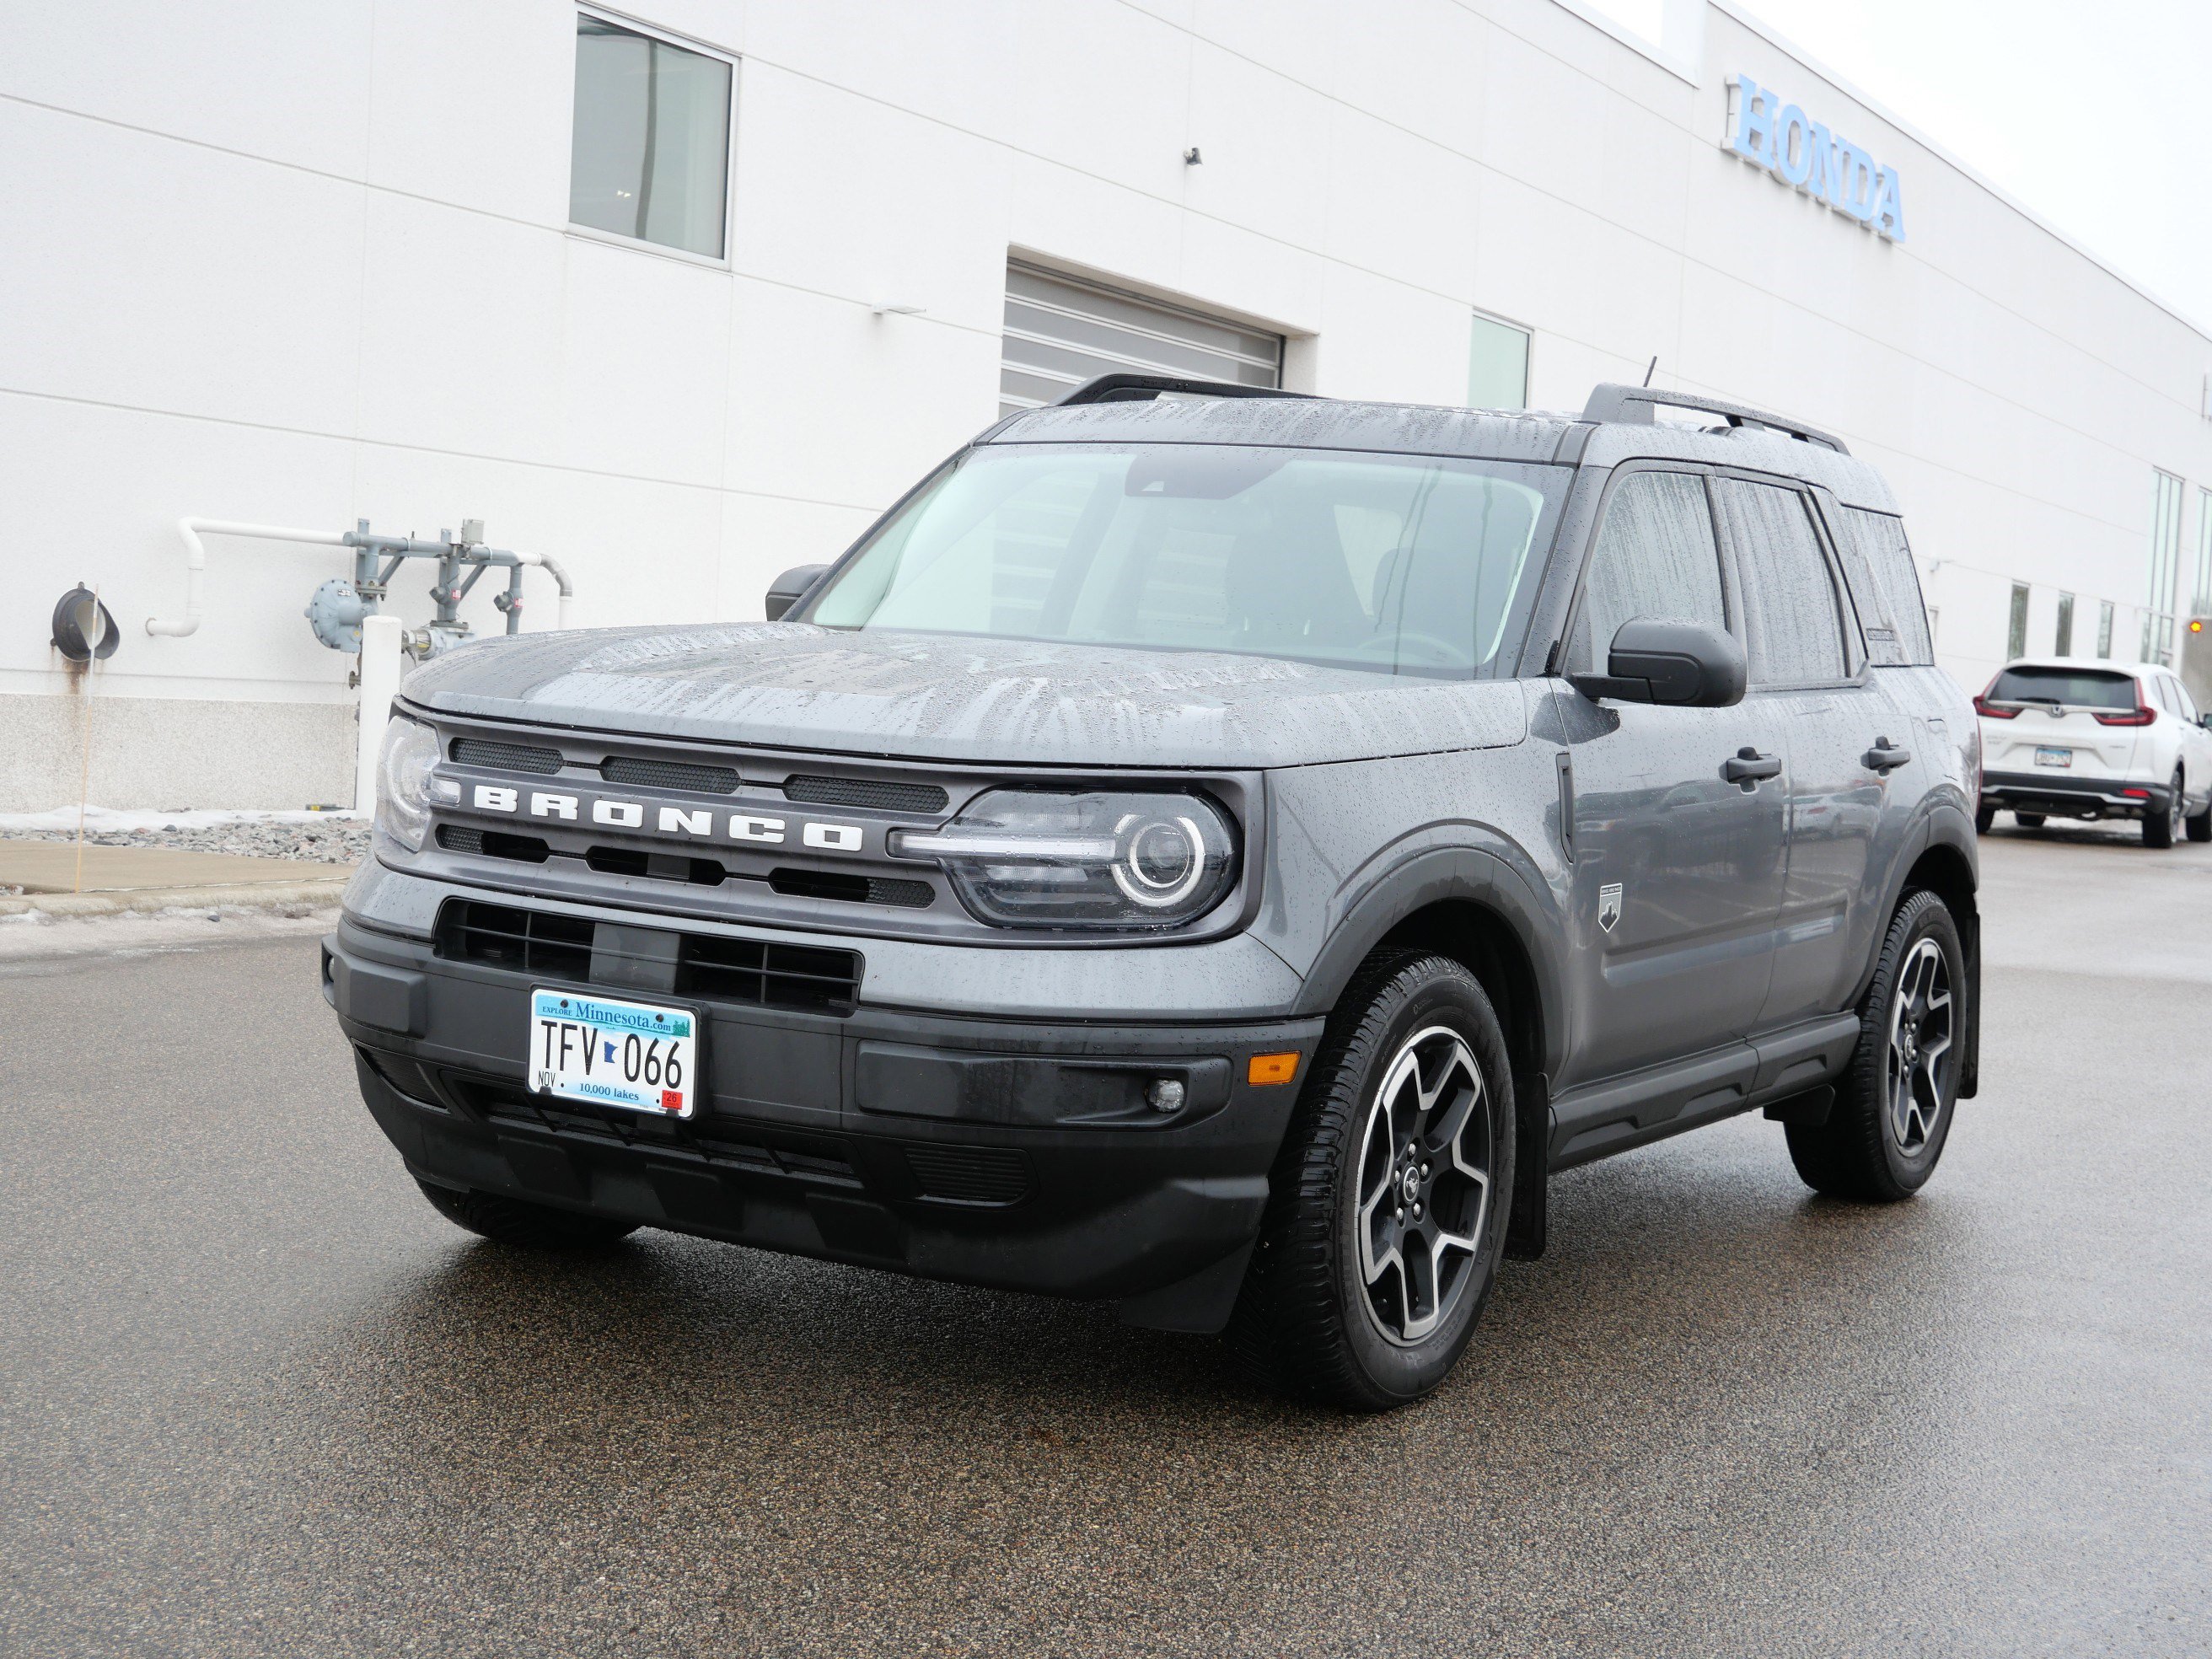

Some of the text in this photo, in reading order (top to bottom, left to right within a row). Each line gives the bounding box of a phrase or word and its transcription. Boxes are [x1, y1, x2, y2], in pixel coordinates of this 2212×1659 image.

[1731, 72, 1906, 244] HONDA
[474, 785, 863, 852] BRONCO
[542, 1006, 572, 1017] EXPLORE
[540, 1020, 682, 1089] TFV 066
[538, 1070, 556, 1087] NOV
[579, 1082, 639, 1101] 10,000 lakes
[667, 1093, 677, 1103] 26
